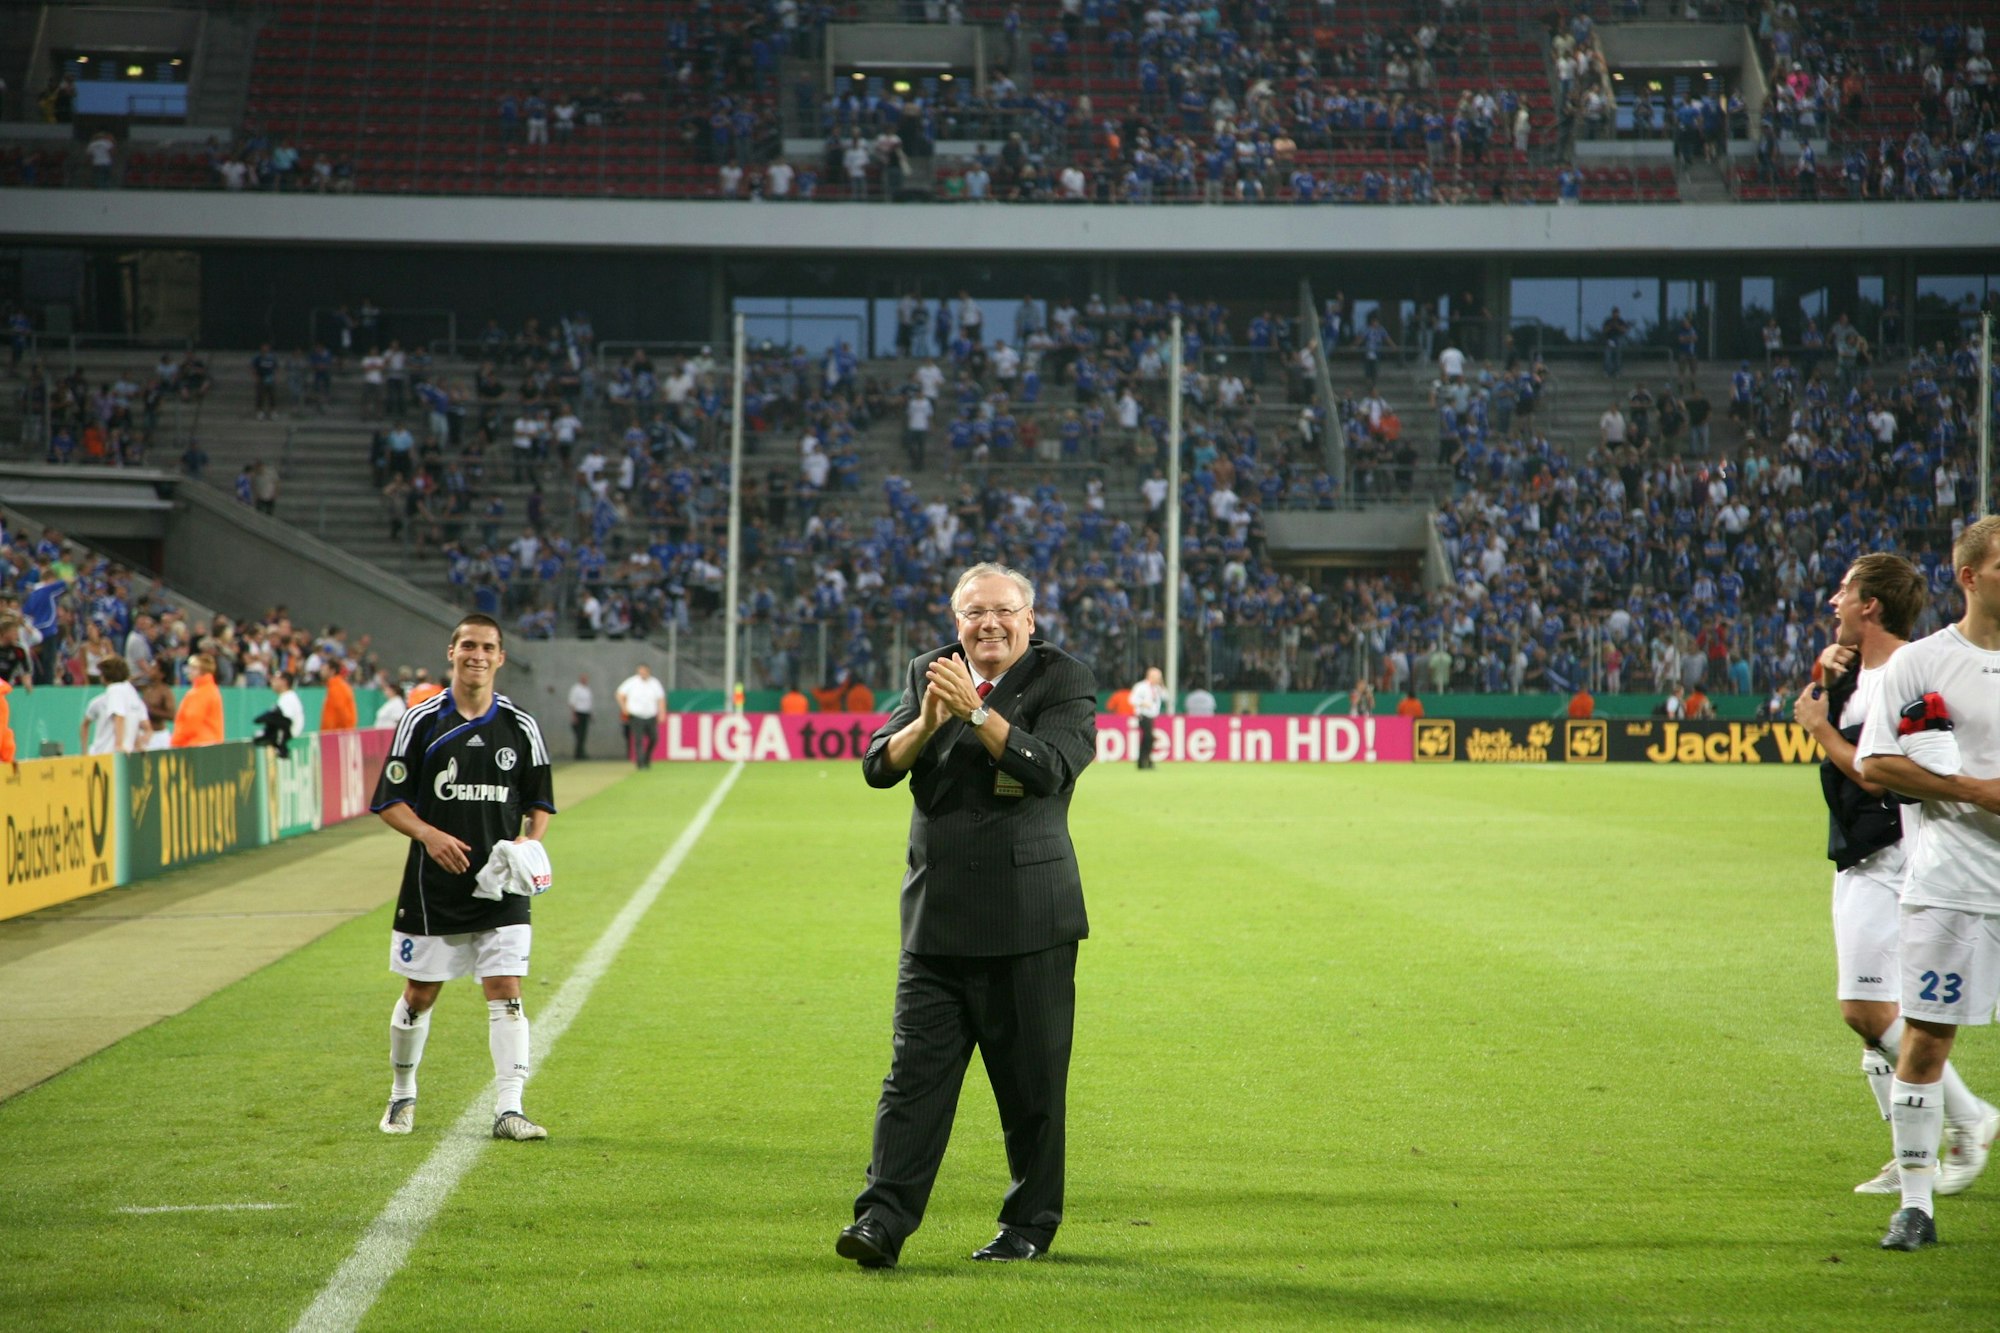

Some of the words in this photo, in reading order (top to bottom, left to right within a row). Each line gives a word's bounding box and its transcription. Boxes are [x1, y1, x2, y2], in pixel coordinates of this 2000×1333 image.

[667, 713, 791, 761] LIGA
[800, 719, 877, 759] tot
[1229, 717, 1273, 762] in
[1287, 717, 1377, 763] HD!
[1466, 743, 1548, 763] Wolfskin
[1467, 727, 1513, 748] Jack
[1646, 722, 1762, 764] Jack
[7, 802, 61, 885] Deutsche
[63, 804, 86, 872] Post
[400, 938, 413, 963] 8
[1857, 975, 1883, 984] JAKO
[1919, 970, 1963, 1004] 23
